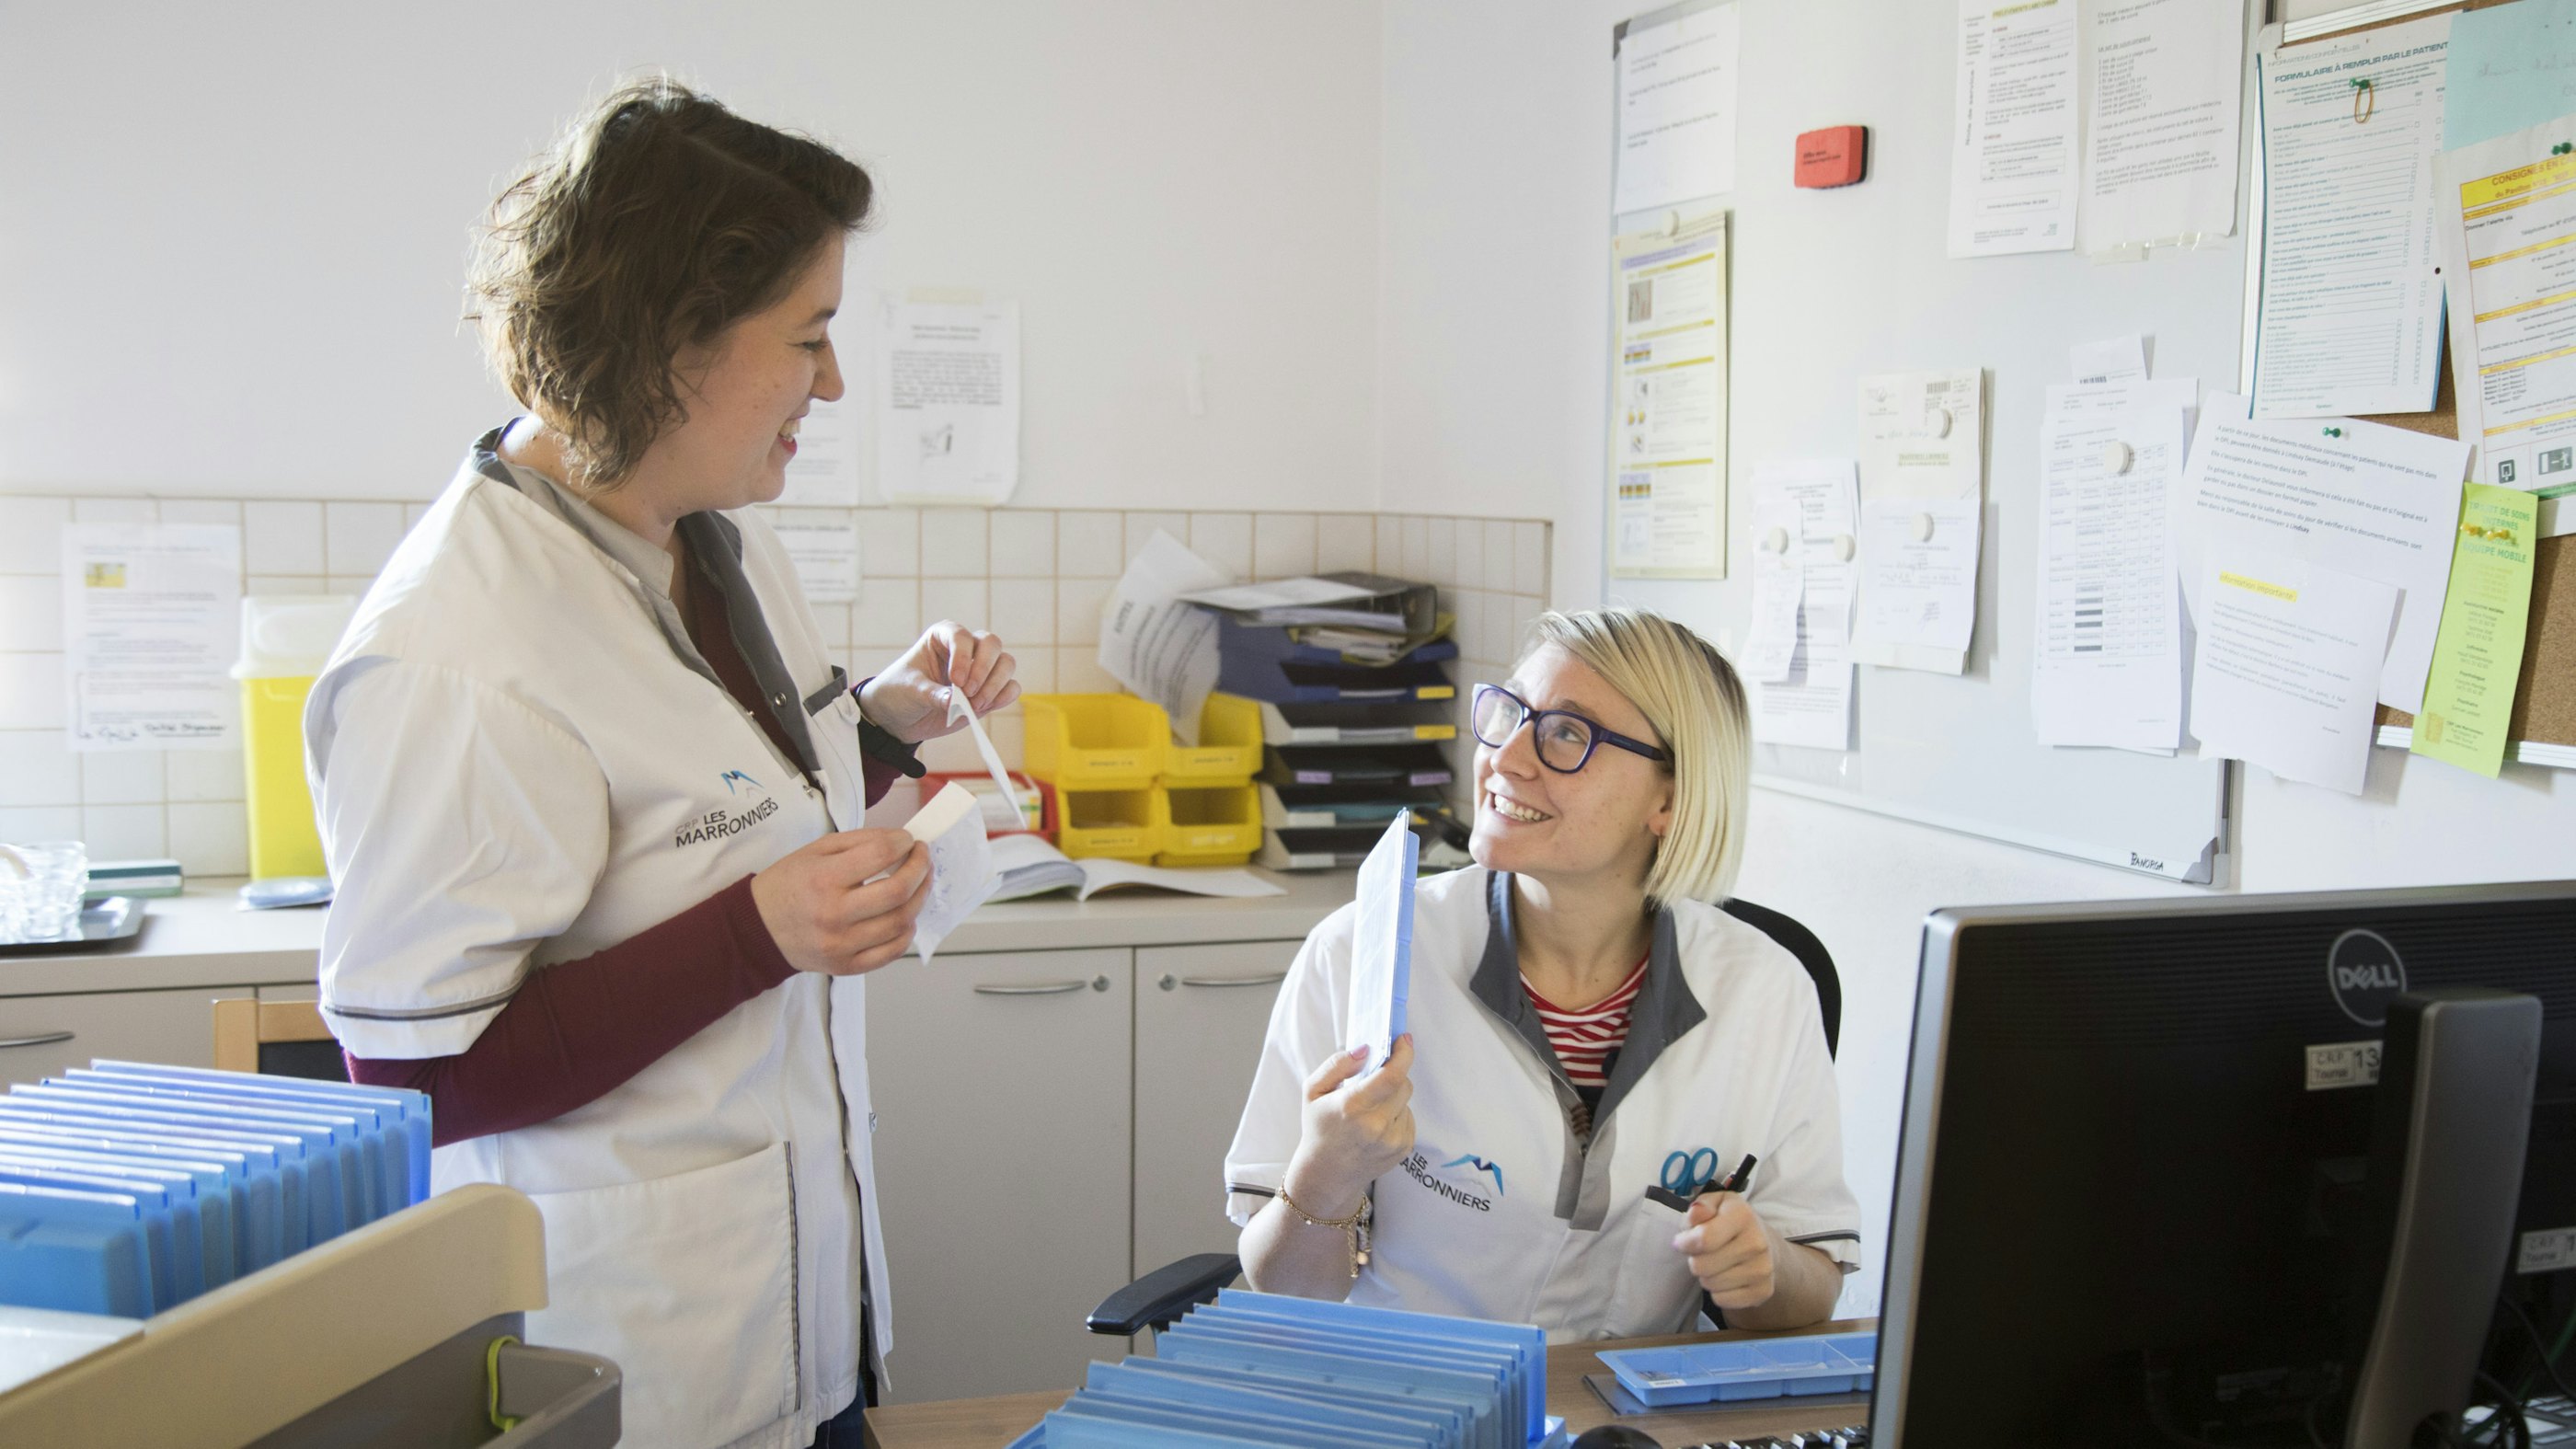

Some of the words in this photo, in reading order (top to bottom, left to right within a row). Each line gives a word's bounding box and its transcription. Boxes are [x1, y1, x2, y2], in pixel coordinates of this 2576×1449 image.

[2274, 66, 2333, 84] FORMULAIRE
[2335, 63, 2340, 71] À
[2342, 56, 2381, 70] REMPLIR
[2382, 53, 2400, 63] PAR
[2401, 50, 2410, 58] LE
[2412, 41, 2448, 55] PATIENT
[2491, 165, 2545, 186] CONSIGNES
[2505, 184, 2531, 195] Pavillon
[2466, 223, 2485, 231] Donner
[2230, 440, 2250, 448] peuvent
[2285, 451, 2304, 461] Lindsay
[2270, 436, 2297, 447] documents
[2298, 442, 2323, 453] médicaux
[2323, 448, 2351, 458] concernant
[2359, 455, 2377, 466] patients
[2378, 460, 2386, 469] qui
[2425, 471, 2437, 479] dans
[2262, 462, 2278, 470] mettre
[2242, 473, 2261, 481] docteur
[2299, 486, 2325, 498] informera
[2257, 488, 2274, 497] dossier
[2283, 493, 2299, 502] format
[2200, 489, 2214, 498] Merci
[2264, 505, 2275, 513] salle
[2305, 515, 2316, 523] jour
[2325, 521, 2343, 530] vérifier
[2358, 528, 2386, 541] documents
[2386, 535, 2409, 546] arrivants
[2410, 542, 2421, 550] sont
[2236, 510, 2249, 518] avant
[2265, 517, 2285, 528] envoyer
[2290, 523, 2309, 534] Lindsay
[2500, 508, 2510, 516] DE
[2512, 510, 2531, 522] SOINS
[2498, 549, 2527, 563] MOBILE
[675, 819, 698, 835] CRP
[704, 810, 727, 825] LES
[675, 798, 779, 848] MARRONNIERS
[2338, 964, 2398, 991] DELL
[1412, 1152, 1428, 1170] LES
[1399, 1157, 1491, 1213] ARRONNIERS
